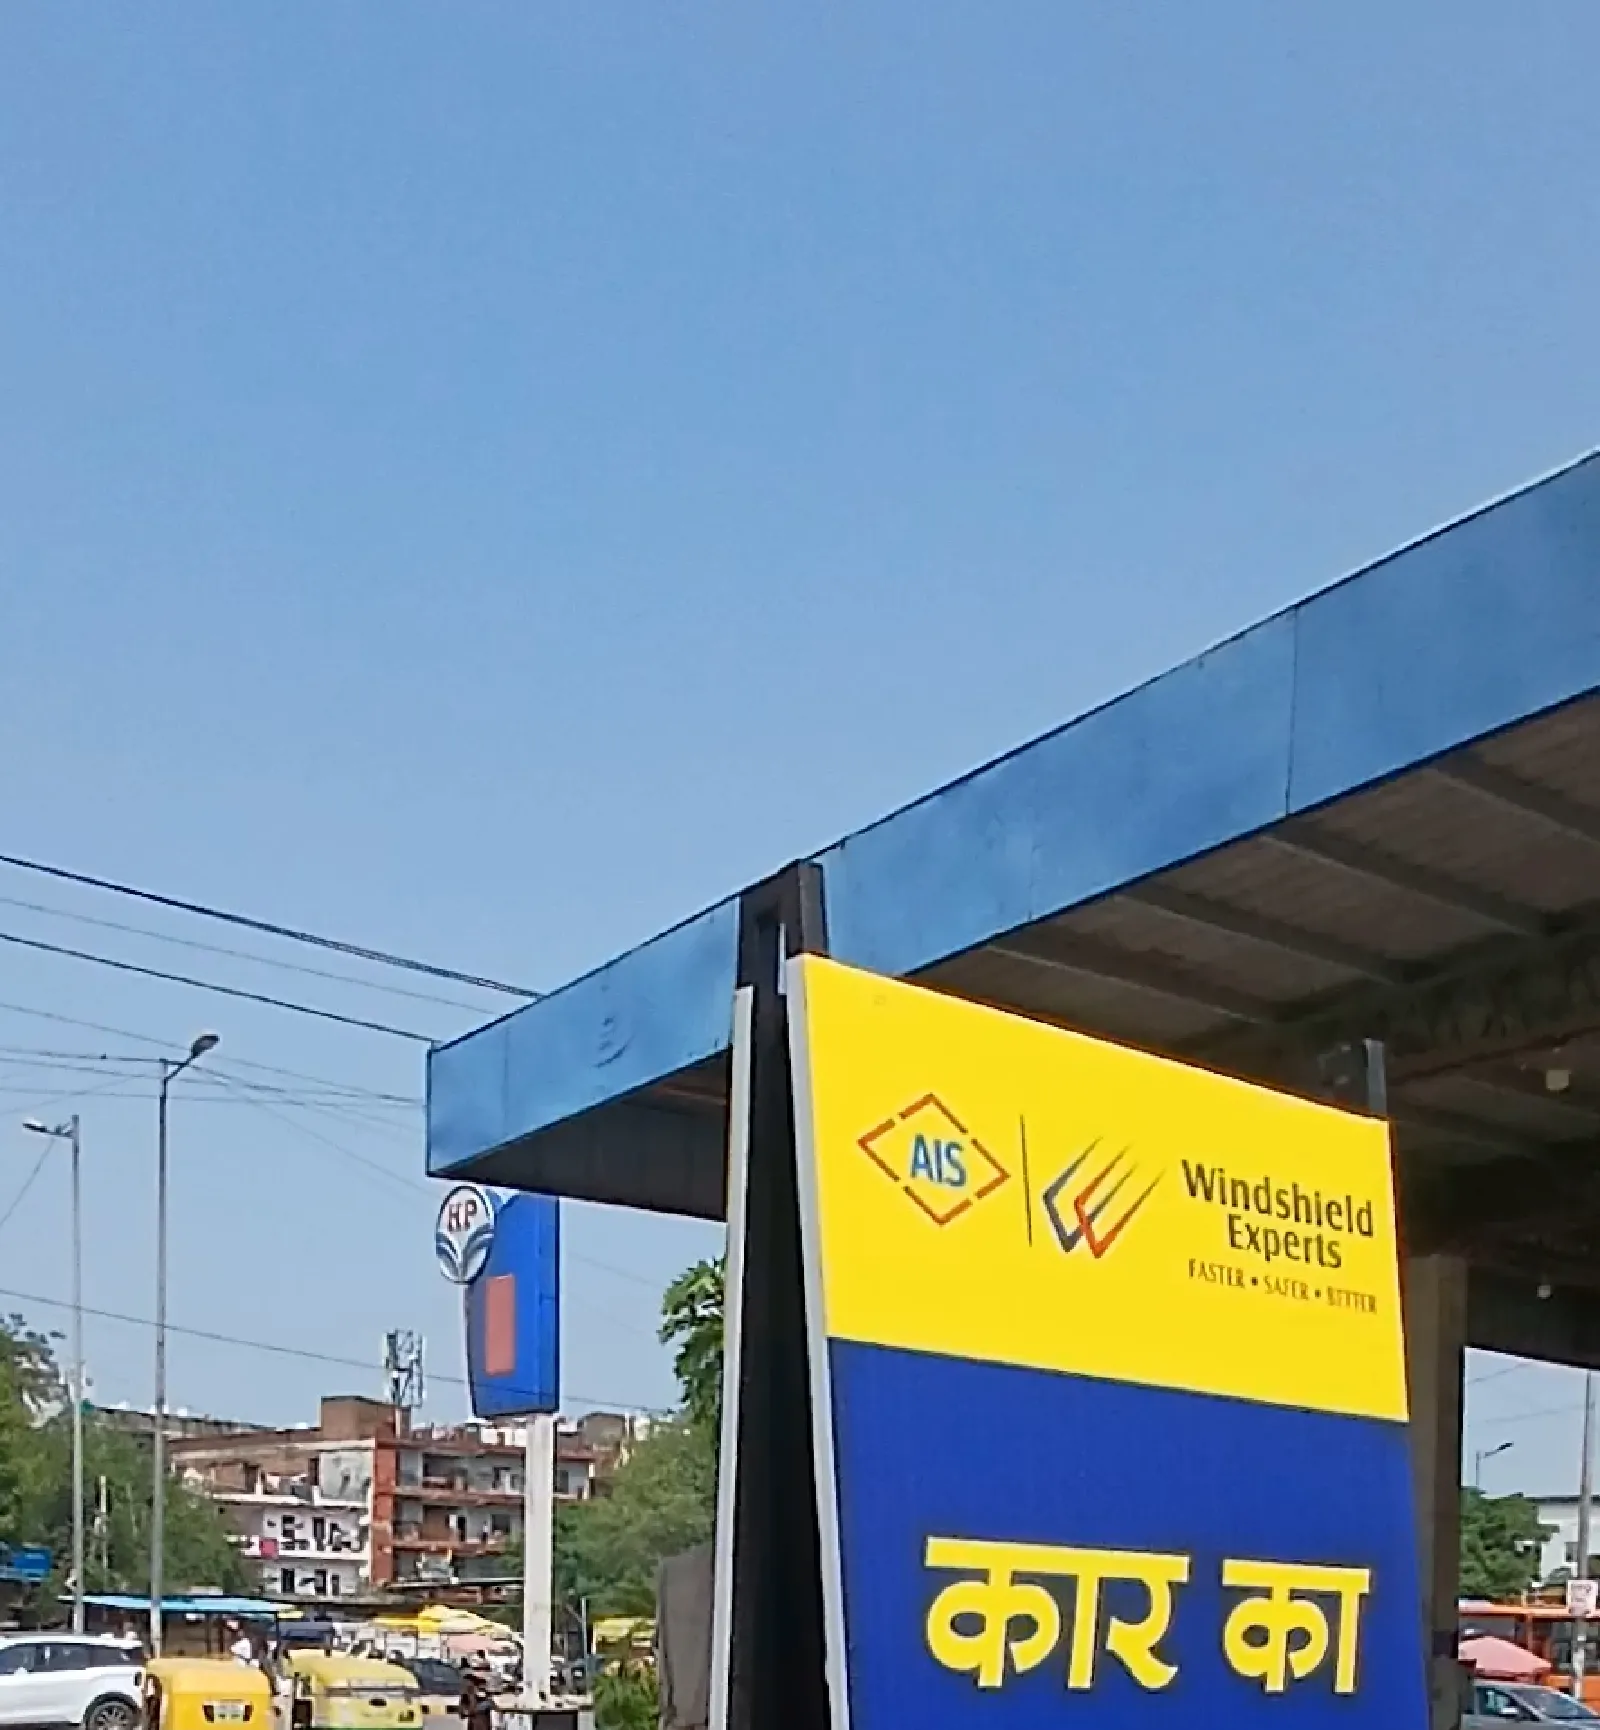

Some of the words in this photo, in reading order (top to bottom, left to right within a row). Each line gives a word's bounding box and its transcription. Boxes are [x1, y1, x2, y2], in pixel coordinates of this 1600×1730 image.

[910, 1133, 967, 1188] AIS
[447, 1199, 478, 1232] HP
[1180, 1159, 1374, 1238] Windshield
[1227, 1213, 1342, 1268] Experts
[1188, 1258, 1246, 1288] FASTER
[1263, 1275, 1310, 1301] SAFER
[1326, 1285, 1378, 1315] BETTER
[923, 1538, 1188, 1690] कार
[1220, 1559, 1370, 1691] का
